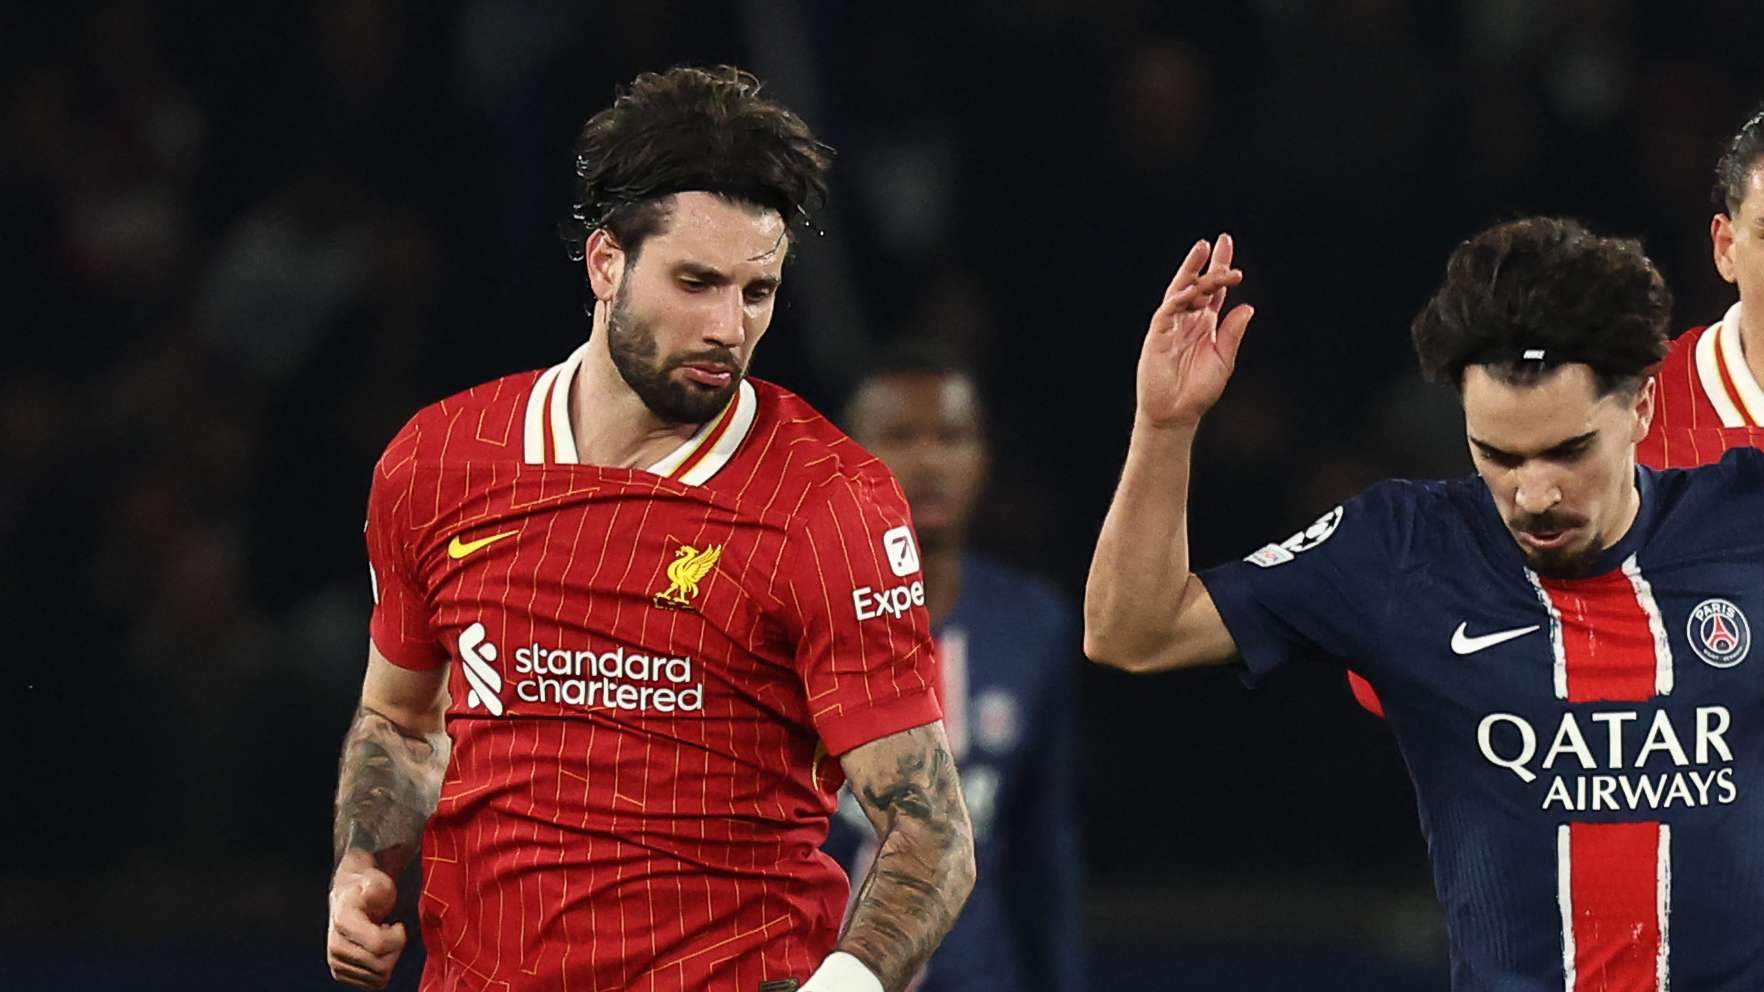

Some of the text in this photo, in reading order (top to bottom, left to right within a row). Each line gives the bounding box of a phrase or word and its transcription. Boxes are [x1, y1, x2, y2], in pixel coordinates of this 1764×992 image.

[853, 577, 925, 621] Expe
[1695, 603, 1735, 621] PARIS
[515, 642, 691, 683] standard
[517, 675, 704, 712] chartered
[1477, 705, 1734, 783] QATAR
[1541, 767, 1737, 811] AIRWAYS
